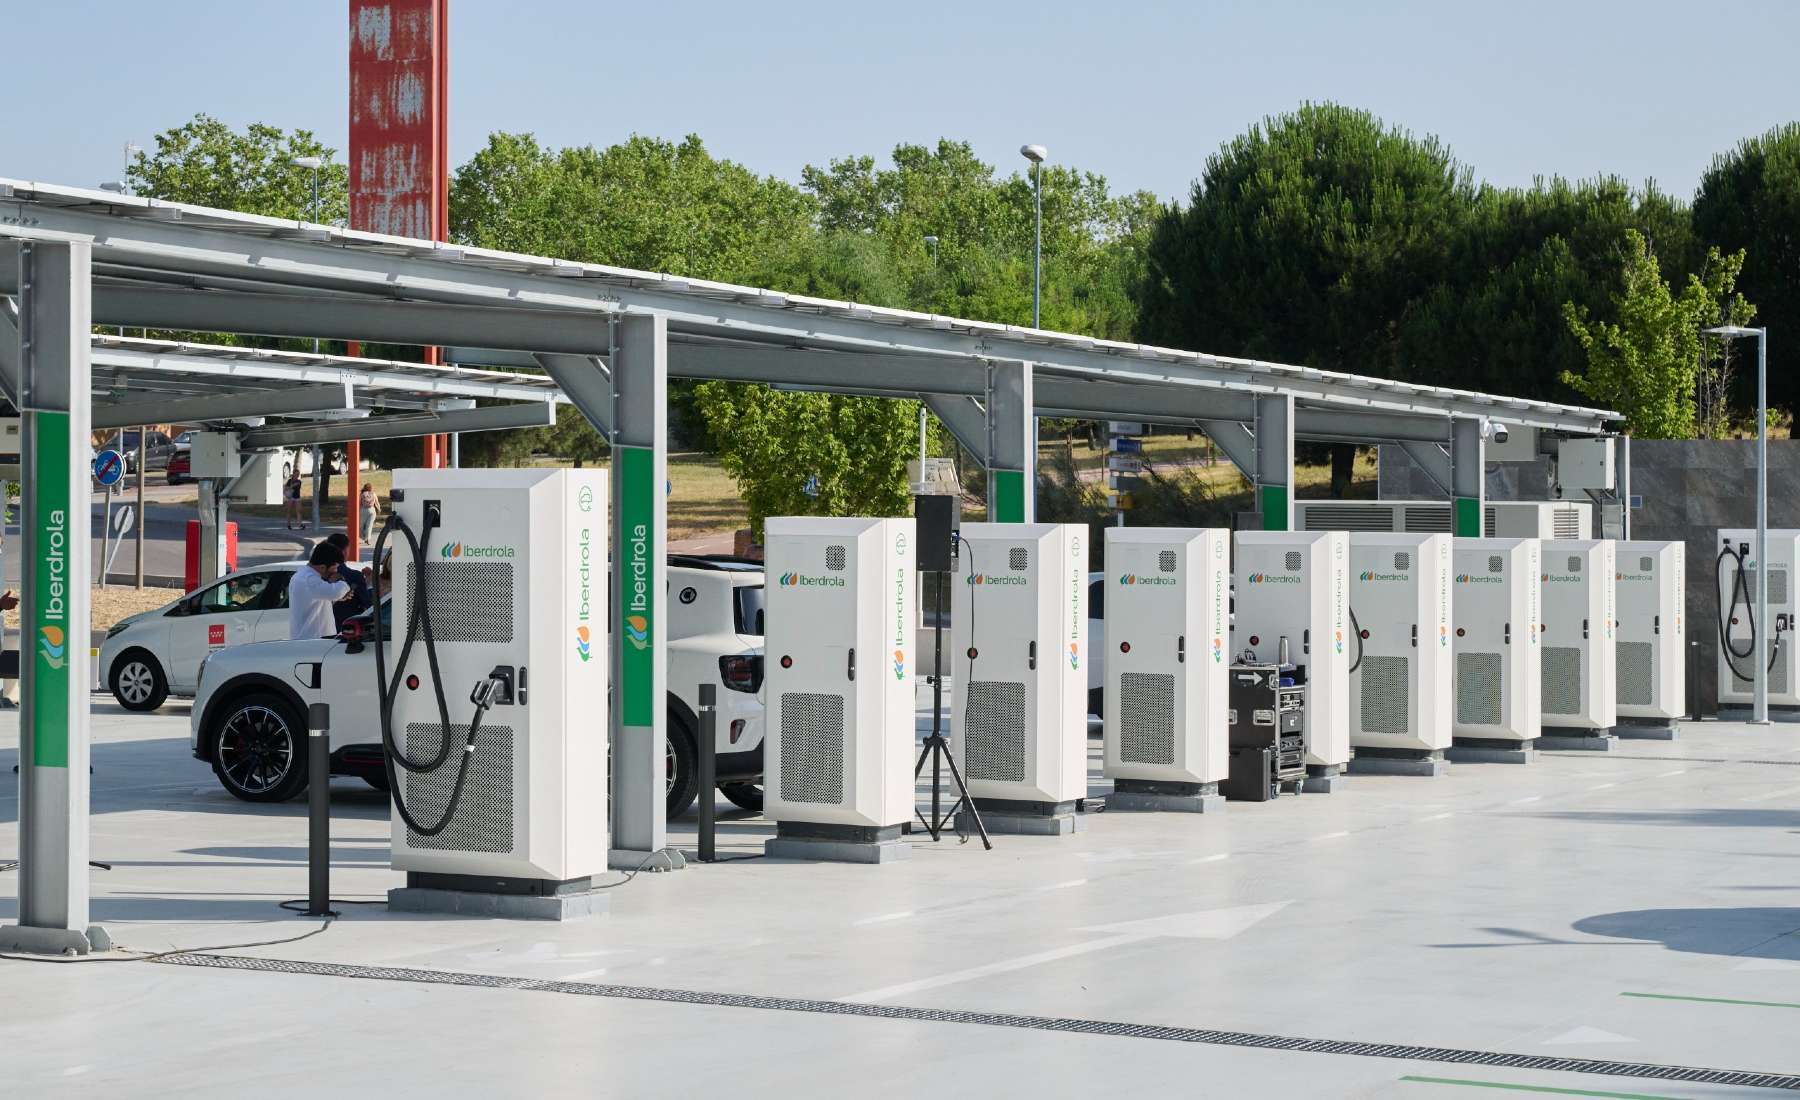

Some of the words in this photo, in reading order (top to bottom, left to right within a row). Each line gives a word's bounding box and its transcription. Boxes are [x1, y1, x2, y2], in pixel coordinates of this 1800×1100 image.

[463, 544, 515, 558] Iberdrola
[46, 509, 65, 620] Iberdrola
[630, 524, 646, 611] Iberdrola
[579, 528, 590, 621] Iberdrola
[985, 575, 1027, 585] Iberdrola
[1264, 575, 1301, 584] Iberdrola
[1374, 573, 1409, 582] Iberdrola
[1470, 575, 1502, 584] Iberdrola
[1549, 574, 1581, 583] Iberdrola
[799, 575, 845, 587] Iberdrola
[1137, 576, 1176, 586] Iberdrola
[896, 568, 904, 646] Iberdrola
